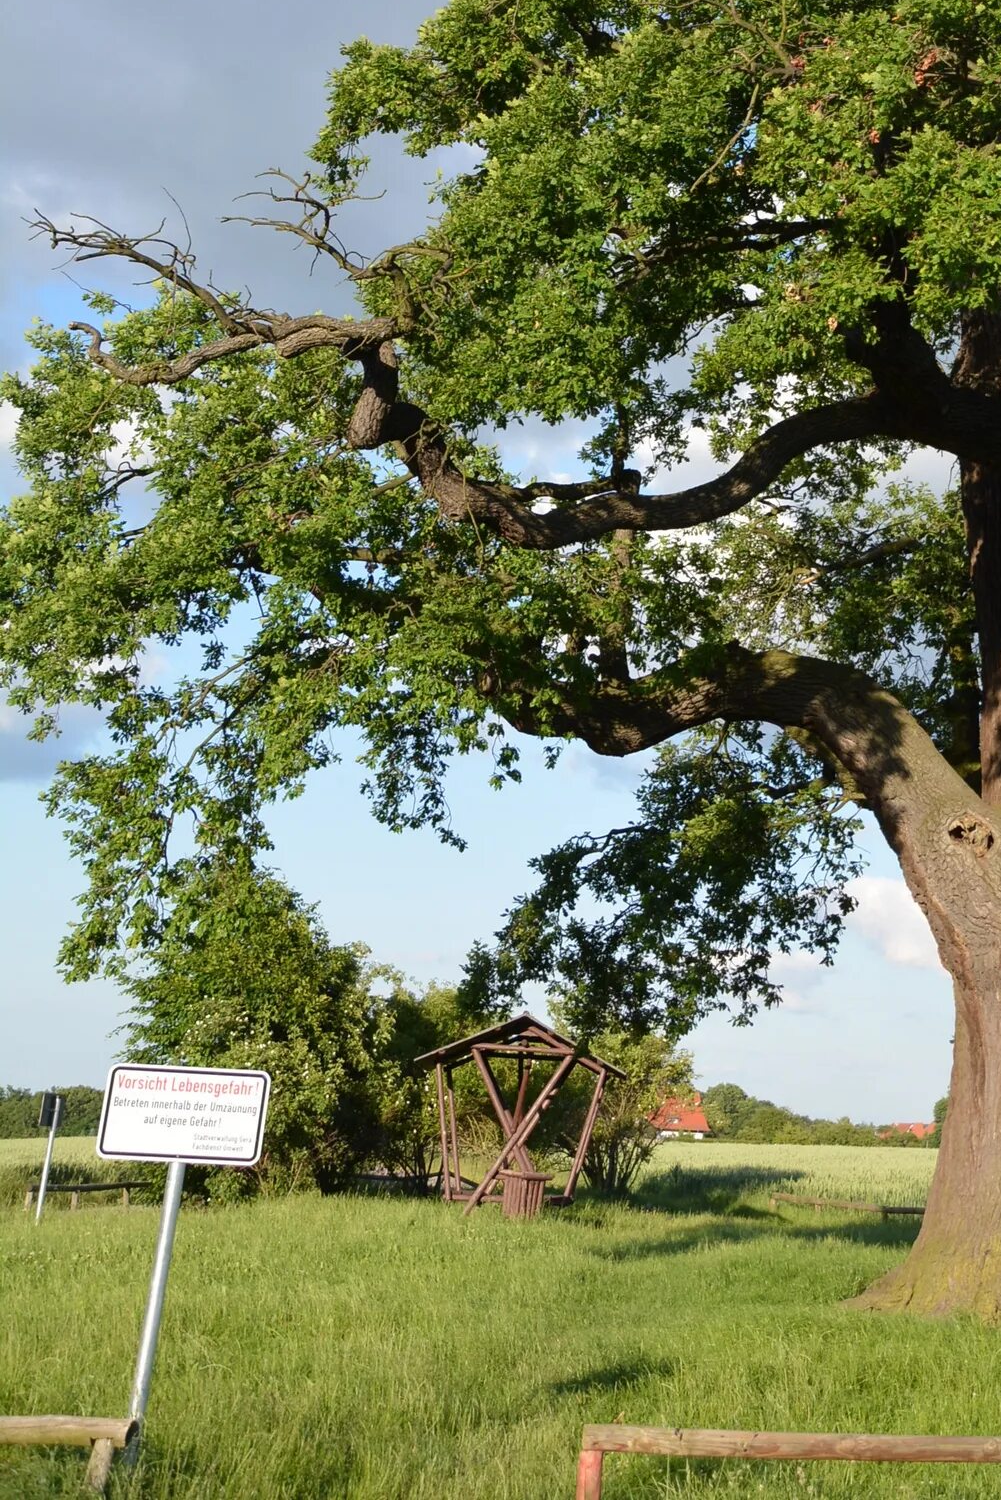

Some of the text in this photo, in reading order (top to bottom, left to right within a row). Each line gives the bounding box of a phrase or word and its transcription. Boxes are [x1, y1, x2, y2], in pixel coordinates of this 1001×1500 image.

[118, 1075, 259, 1098] Vorsicht Lebensgefahr!
[114, 1097, 149, 1108] Betreten
[152, 1100, 191, 1110] innerhalb
[194, 1103, 207, 1111] der
[144, 1115, 221, 1128] auf eigene Gefahr!
